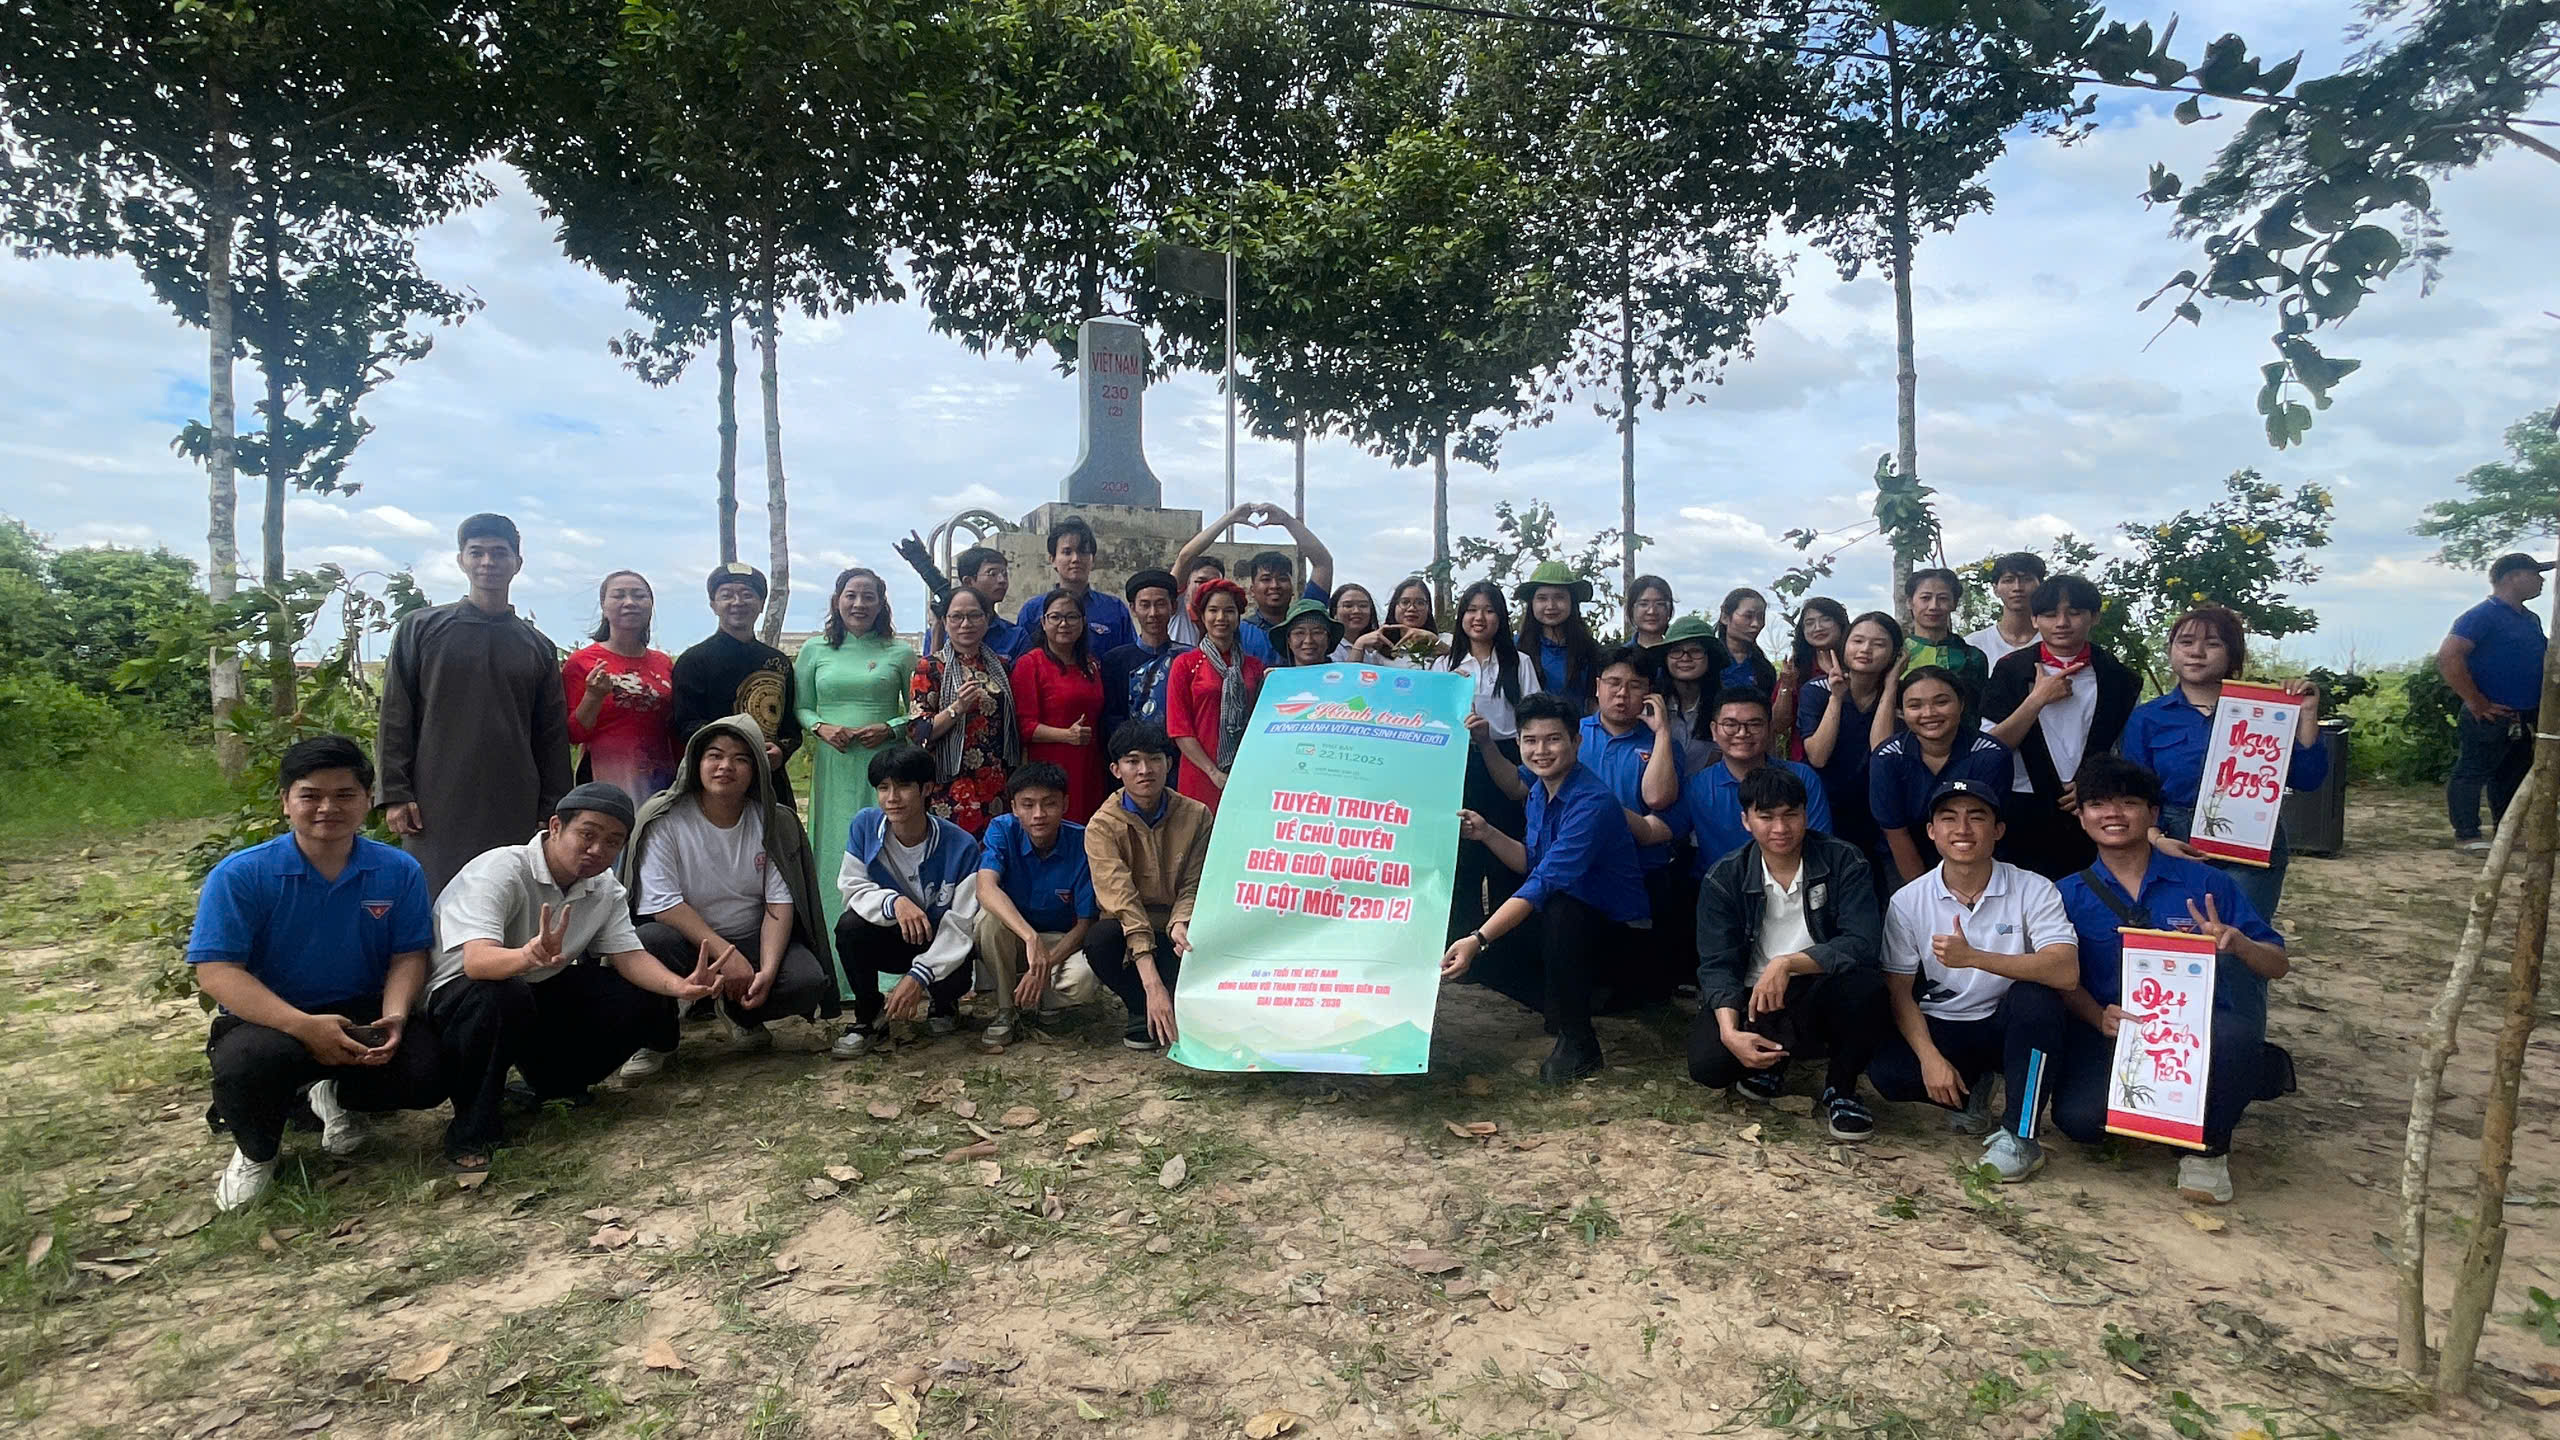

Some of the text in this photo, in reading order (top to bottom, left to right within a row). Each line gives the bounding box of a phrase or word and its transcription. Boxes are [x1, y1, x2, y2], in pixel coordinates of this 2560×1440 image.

[1115, 355, 1139, 375] NAM
[1102, 385, 1129, 400] 230
[1108, 406, 1123, 417] (2)
[1308, 702, 1424, 728] Hành trình
[1300, 722, 1331, 733] HÀNH
[1331, 724, 1349, 735] VỚI
[1349, 725, 1370, 738] HỌC
[1373, 728, 1398, 739] SINH
[1398, 729, 1420, 742] BIÊN
[1421, 732, 1443, 745] GIỚI
[1320, 750, 1384, 766] 22.11.2025
[1272, 791, 1409, 825] TUYÊN TRUYỀN
[1275, 818, 1394, 850] VỀ CHỦ QUYỀN
[1247, 849, 1410, 887] BIÊN GIỚI QUỐC GIA
[1236, 882, 1263, 910] TẠI
[1266, 883, 1300, 915] CỘT
[1302, 885, 1345, 918] MỐC
[1348, 896, 1385, 919] 230
[1320, 969, 1338, 978] NAM
[1273, 982, 1296, 991] THANH
[1295, 997, 1315, 1007] 2025
[1321, 998, 1341, 1008] 2030
